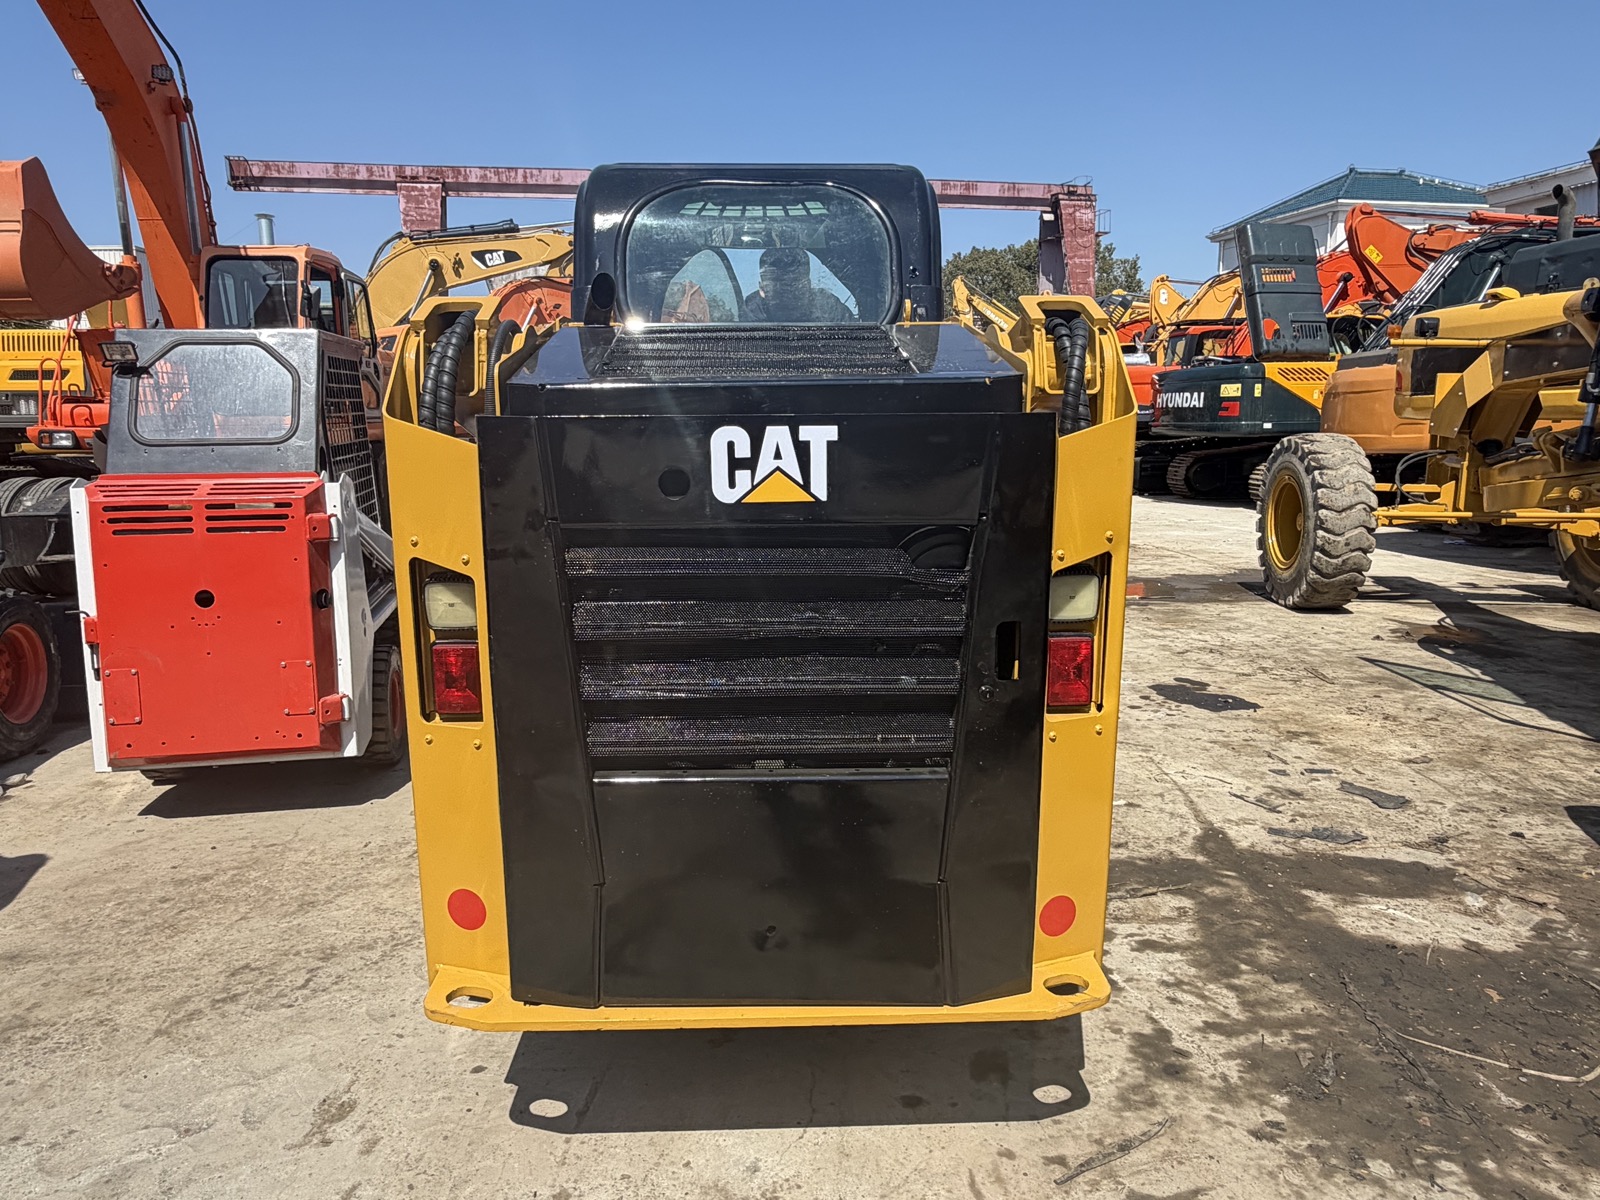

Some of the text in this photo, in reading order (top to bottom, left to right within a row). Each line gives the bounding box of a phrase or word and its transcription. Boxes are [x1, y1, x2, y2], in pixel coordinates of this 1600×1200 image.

[484, 250, 506, 267] CAT
[1156, 392, 1205, 408] HYUNDAI
[710, 425, 838, 504] CAT
